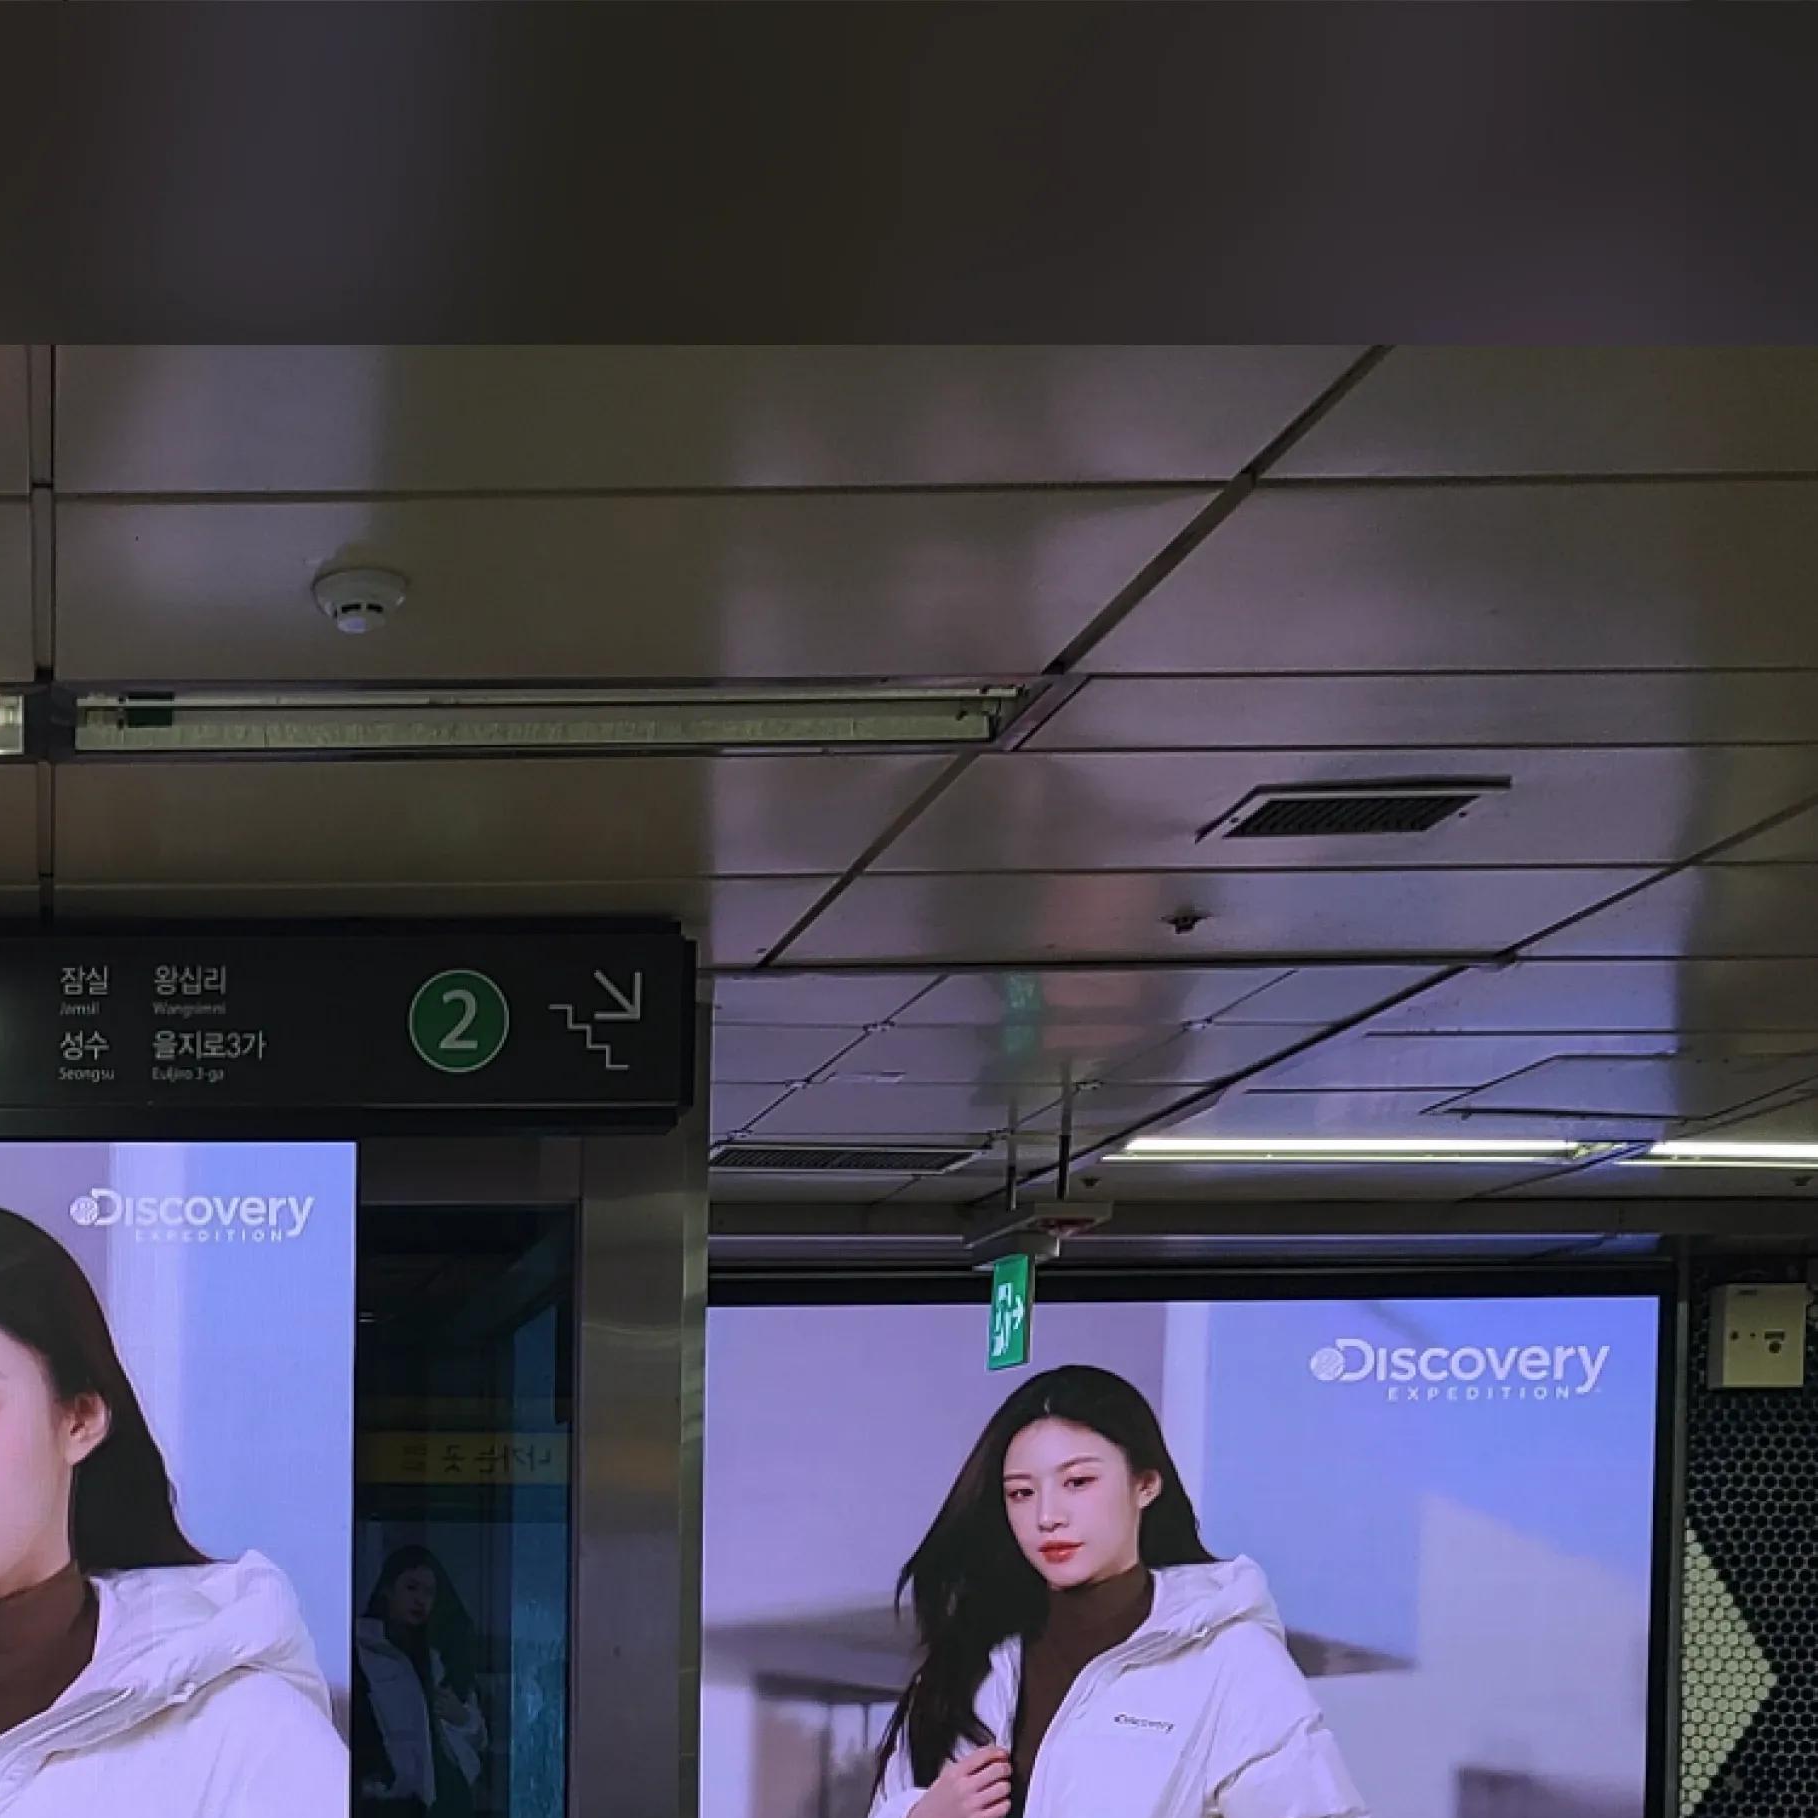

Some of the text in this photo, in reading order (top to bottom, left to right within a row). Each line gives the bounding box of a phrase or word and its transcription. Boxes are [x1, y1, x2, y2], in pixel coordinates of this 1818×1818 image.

[60, 965, 109, 996] 잠실
[154, 965, 227, 996] 왕십리
[440, 989, 479, 1049] 2
[60, 1030, 110, 1061] 성수
[152, 1030, 267, 1061] 을지로3가
[58, 1066, 115, 1083] Seongsu
[70, 1187, 316, 1238] Discovery
[135, 1229, 283, 1243] EXPEDITION
[1310, 1338, 1610, 1394] Discovery
[1387, 1386, 1570, 1401] EXPEDITION
